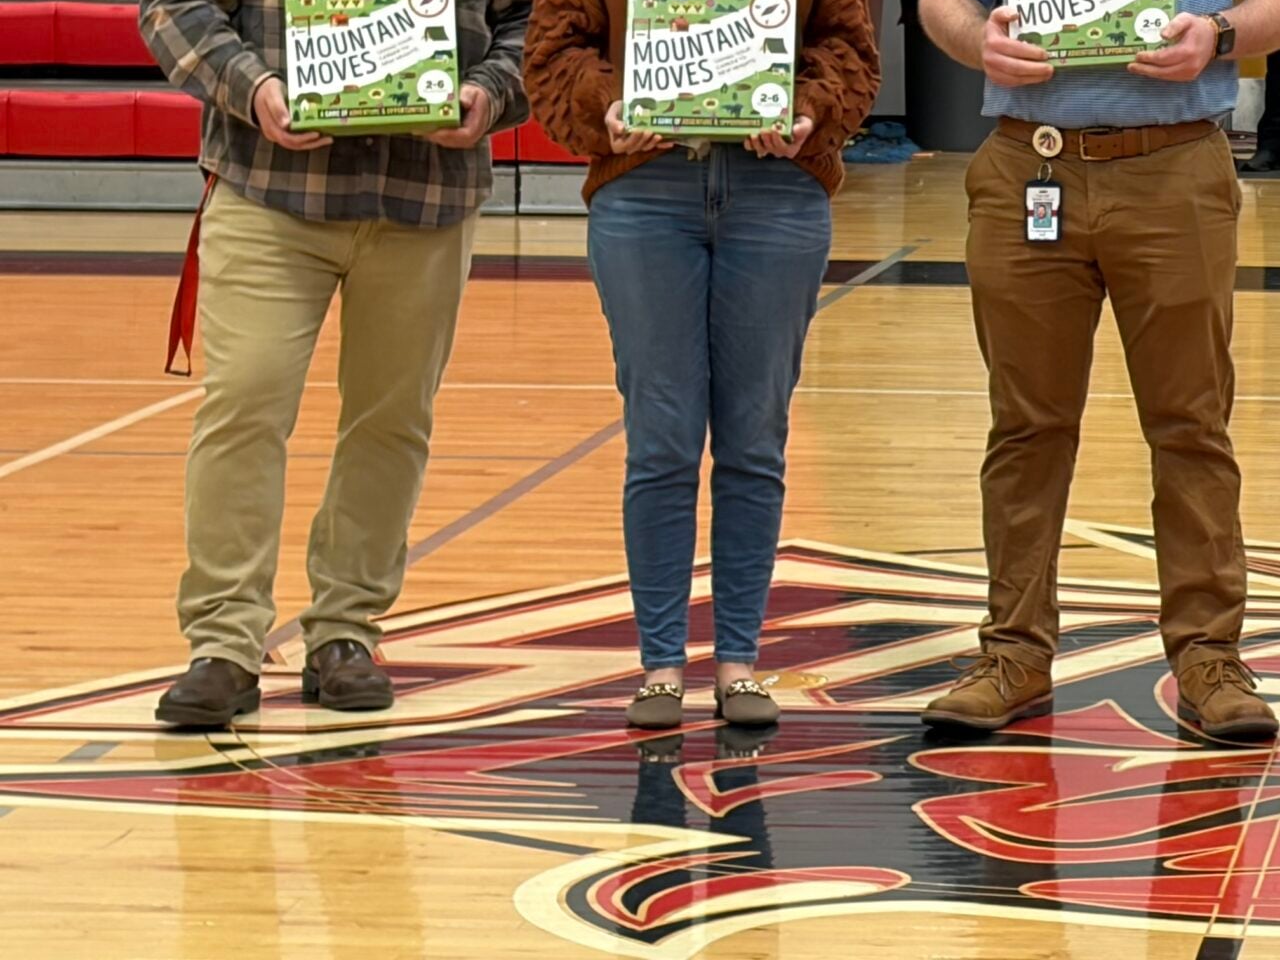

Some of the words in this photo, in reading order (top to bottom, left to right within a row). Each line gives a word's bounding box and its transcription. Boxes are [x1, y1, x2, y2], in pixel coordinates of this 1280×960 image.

[294, 8, 416, 61] MOUNTAIN
[1143, 18, 1161, 28] 2-6
[633, 17, 755, 65] MOUNTAIN
[296, 51, 377, 88] MOVES
[426, 80, 444, 90] 2-6
[633, 59, 713, 92] MOVES
[760, 93, 779, 103] 2-6
